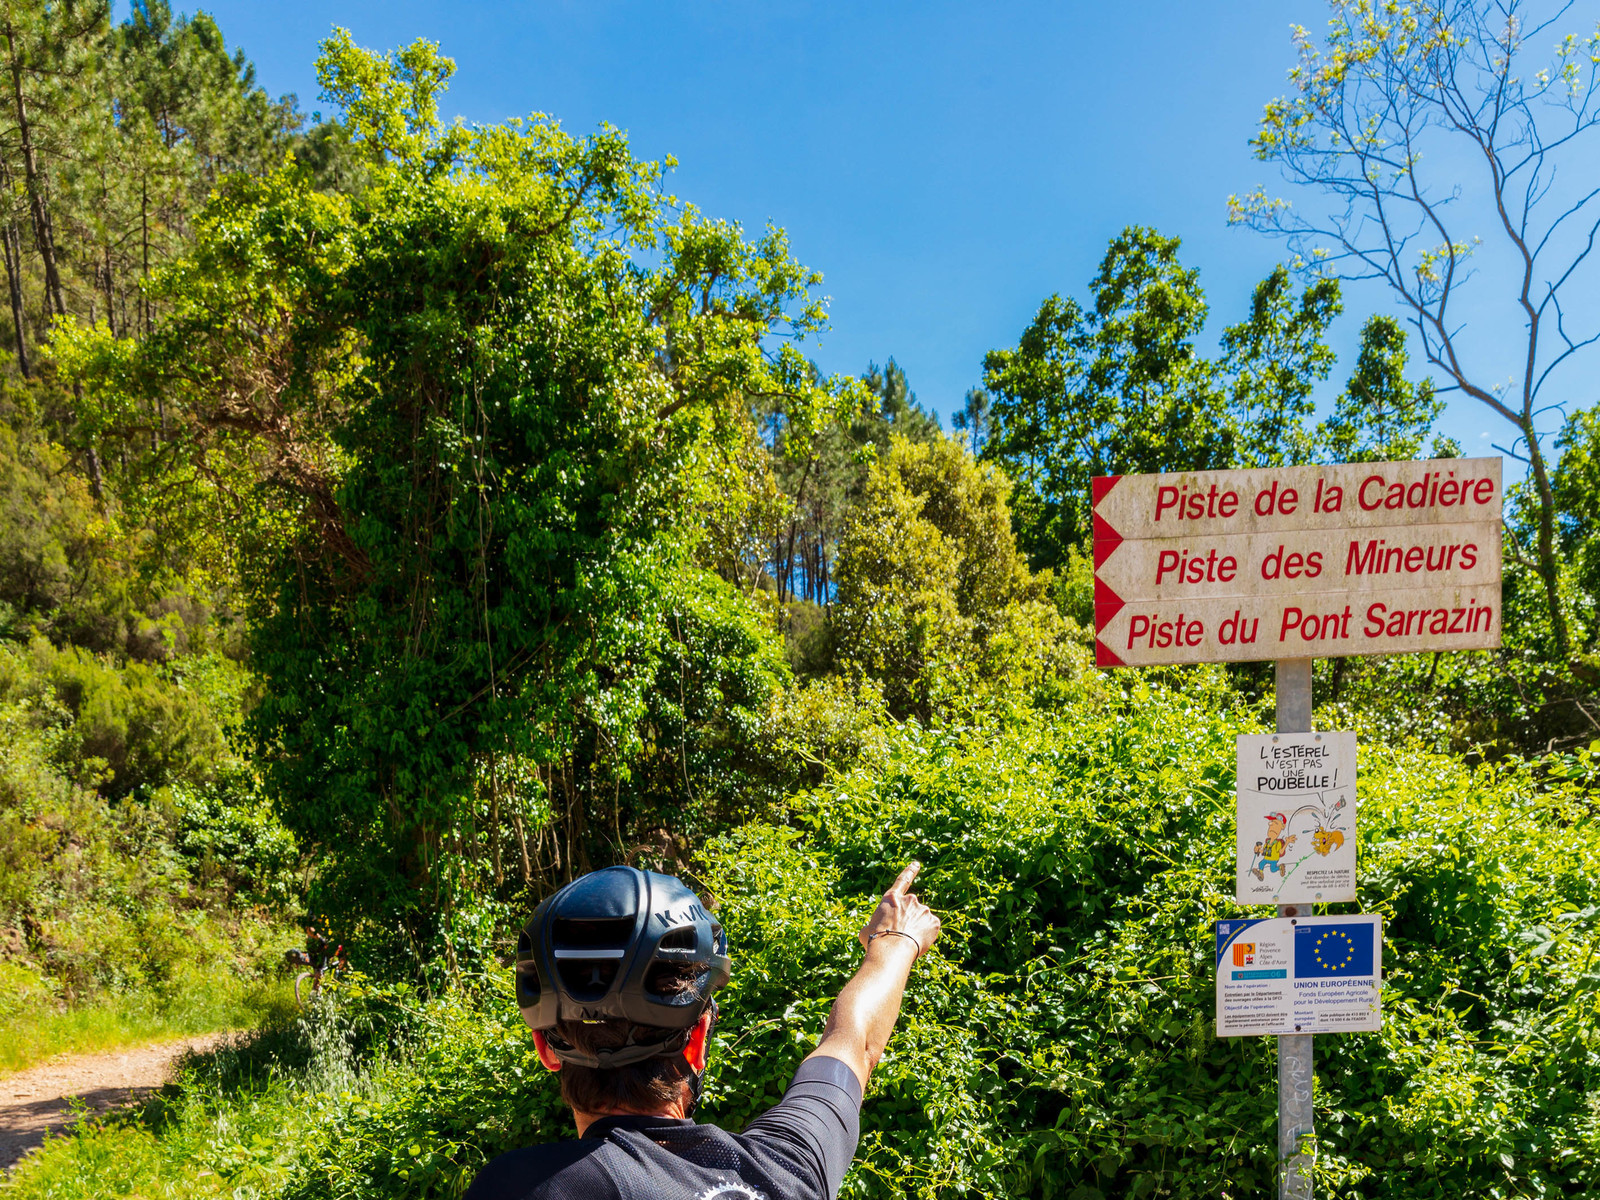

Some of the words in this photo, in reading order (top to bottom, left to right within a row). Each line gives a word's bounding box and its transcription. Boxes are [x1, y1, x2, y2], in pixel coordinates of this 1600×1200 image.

[1153, 484, 1239, 522] Piste
[1254, 480, 1299, 517] de
[1313, 478, 1343, 514] la
[1357, 471, 1495, 512] Cadière
[1155, 548, 1238, 586] Piste
[1260, 545, 1323, 581] des
[1345, 539, 1479, 577] Mineurs
[1127, 613, 1204, 650] Piste
[1217, 610, 1259, 646] du
[1279, 604, 1352, 642] Pont
[1363, 598, 1493, 638] Sarrazin
[1260, 745, 1330, 760] L'ESTÉREL
[1265, 759, 1299, 769] N'EST
[1303, 759, 1323, 769] PAS
[1282, 769, 1305, 778] UNE
[1257, 775, 1329, 791] POUBELLE
[1320, 979, 1374, 988] EUROPÉENNE
